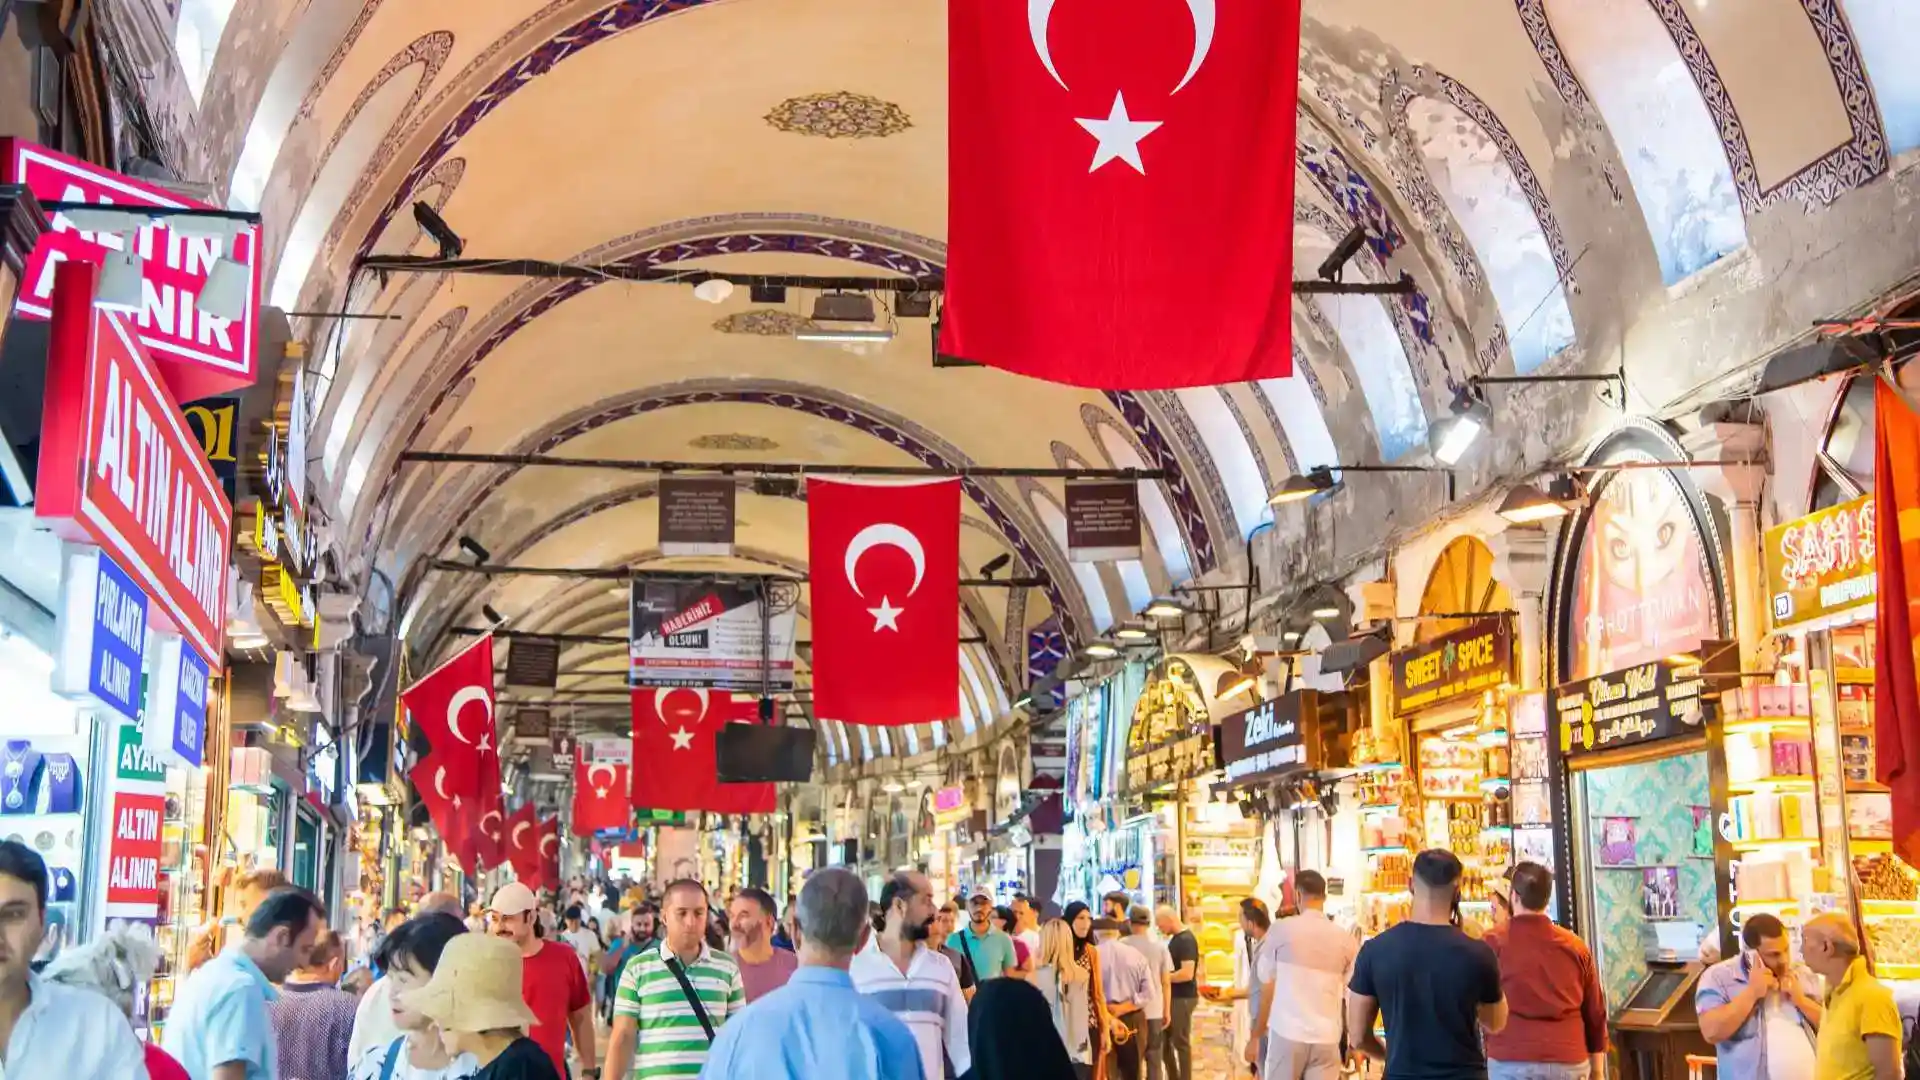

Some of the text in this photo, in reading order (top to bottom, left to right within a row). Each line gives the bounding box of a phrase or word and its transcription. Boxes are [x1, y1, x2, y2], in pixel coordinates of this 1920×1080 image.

[98, 358, 223, 631] ALTIN ALINIR
[96, 570, 143, 655] PIRLANTA
[669, 634, 702, 646] OLSUN!
[1405, 651, 1441, 689] SWEET
[1458, 633, 1493, 671] SPICE
[100, 650, 130, 705] ALINIR
[1244, 702, 1274, 747] Zeki
[553, 754, 574, 764] WC
[117, 807, 158, 841] ALTIN
[110, 857, 156, 889] ALINIR
